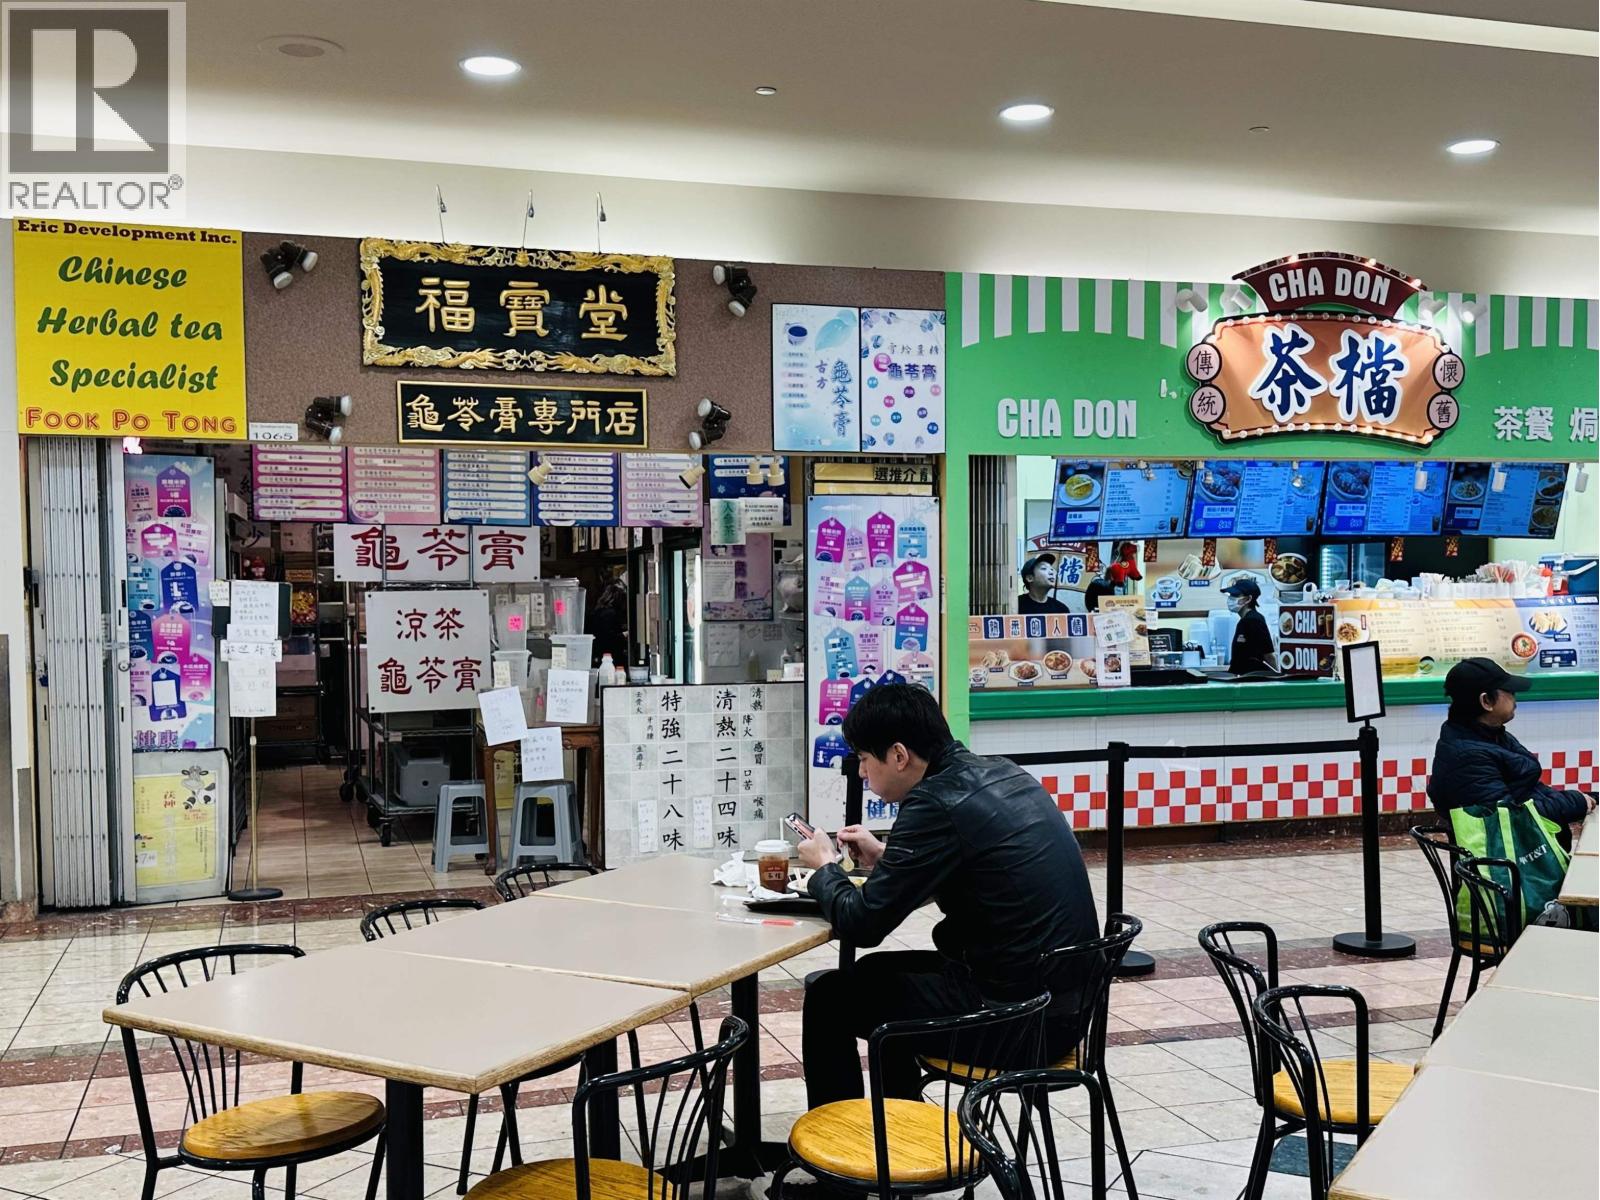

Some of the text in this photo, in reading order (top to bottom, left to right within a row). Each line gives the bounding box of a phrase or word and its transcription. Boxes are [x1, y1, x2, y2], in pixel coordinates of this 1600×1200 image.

[17, 219, 238, 244] Eric Development Inc.
[58, 255, 187, 290] Chinese
[1268, 266, 1391, 306] CHA DON
[37, 306, 223, 341] Herbal tea
[415, 276, 628, 342] 福寶堂
[50, 358, 219, 394] Specialist
[815, 359, 829, 390] 古方
[1255, 328, 1405, 420] 茶檔
[25, 407, 100, 431] FOOK
[161, 410, 238, 434] TONG
[405, 393, 639, 437] 龜苓膏專門店
[997, 398, 1137, 438] CHA DON
[1493, 406, 1554, 442] 茶餐
[253, 431, 294, 441] 1065
[350, 526, 527, 572] 龜苓膏
[396, 607, 465, 642] 涼茶
[1294, 610, 1318, 634] CHA
[377, 656, 483, 695] 龜苓膏
[1295, 648, 1318, 671] DON
[134, 729, 179, 748] 健康
[661, 690, 685, 851] 特強二十八味
[716, 688, 739, 848] 清熱二十四味
